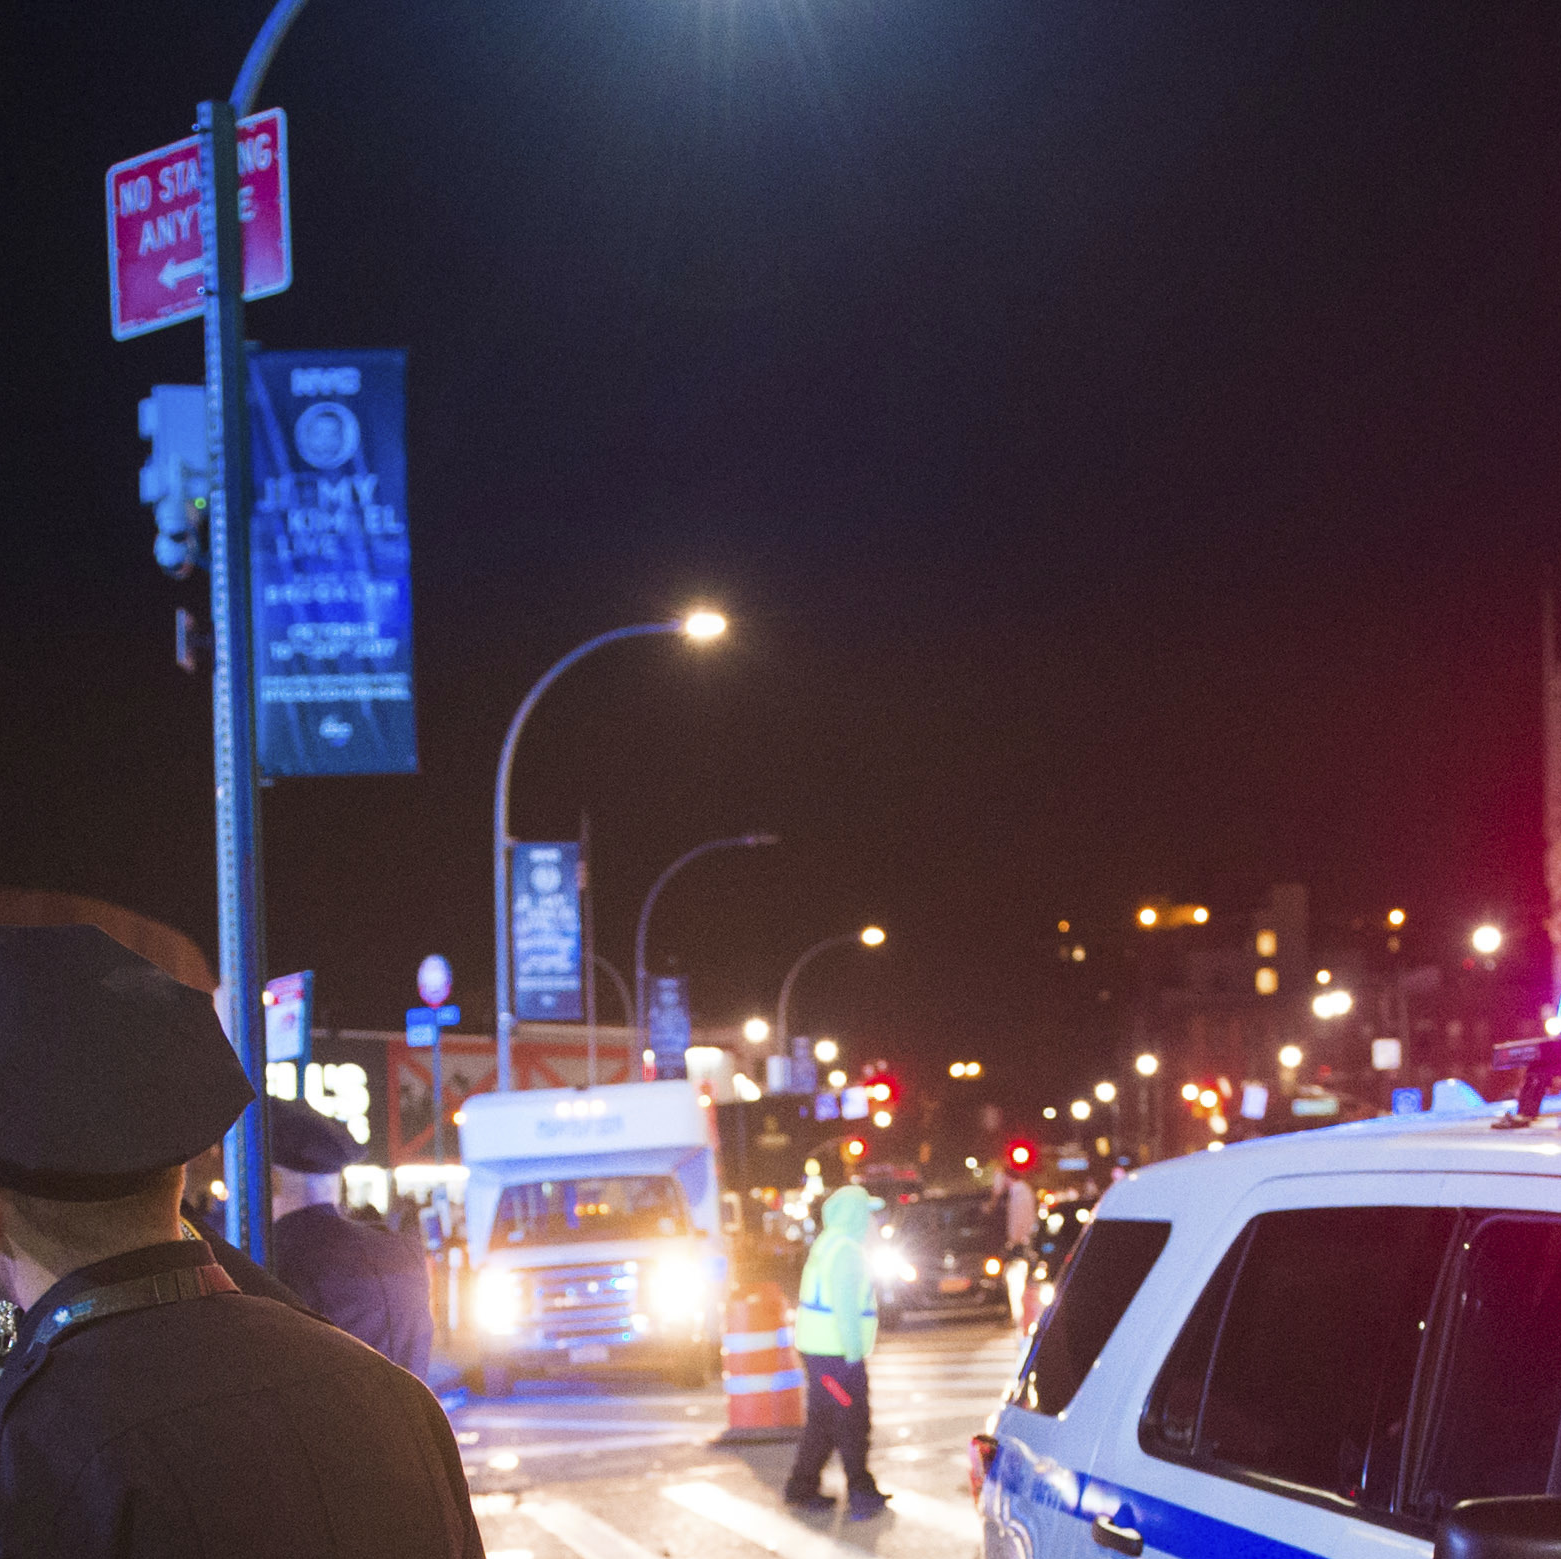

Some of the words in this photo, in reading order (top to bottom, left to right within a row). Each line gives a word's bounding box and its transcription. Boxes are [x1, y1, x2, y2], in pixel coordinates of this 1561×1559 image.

[119, 175, 152, 217] NO
[159, 133, 272, 203] STANG
[138, 186, 256, 257] ANYE
